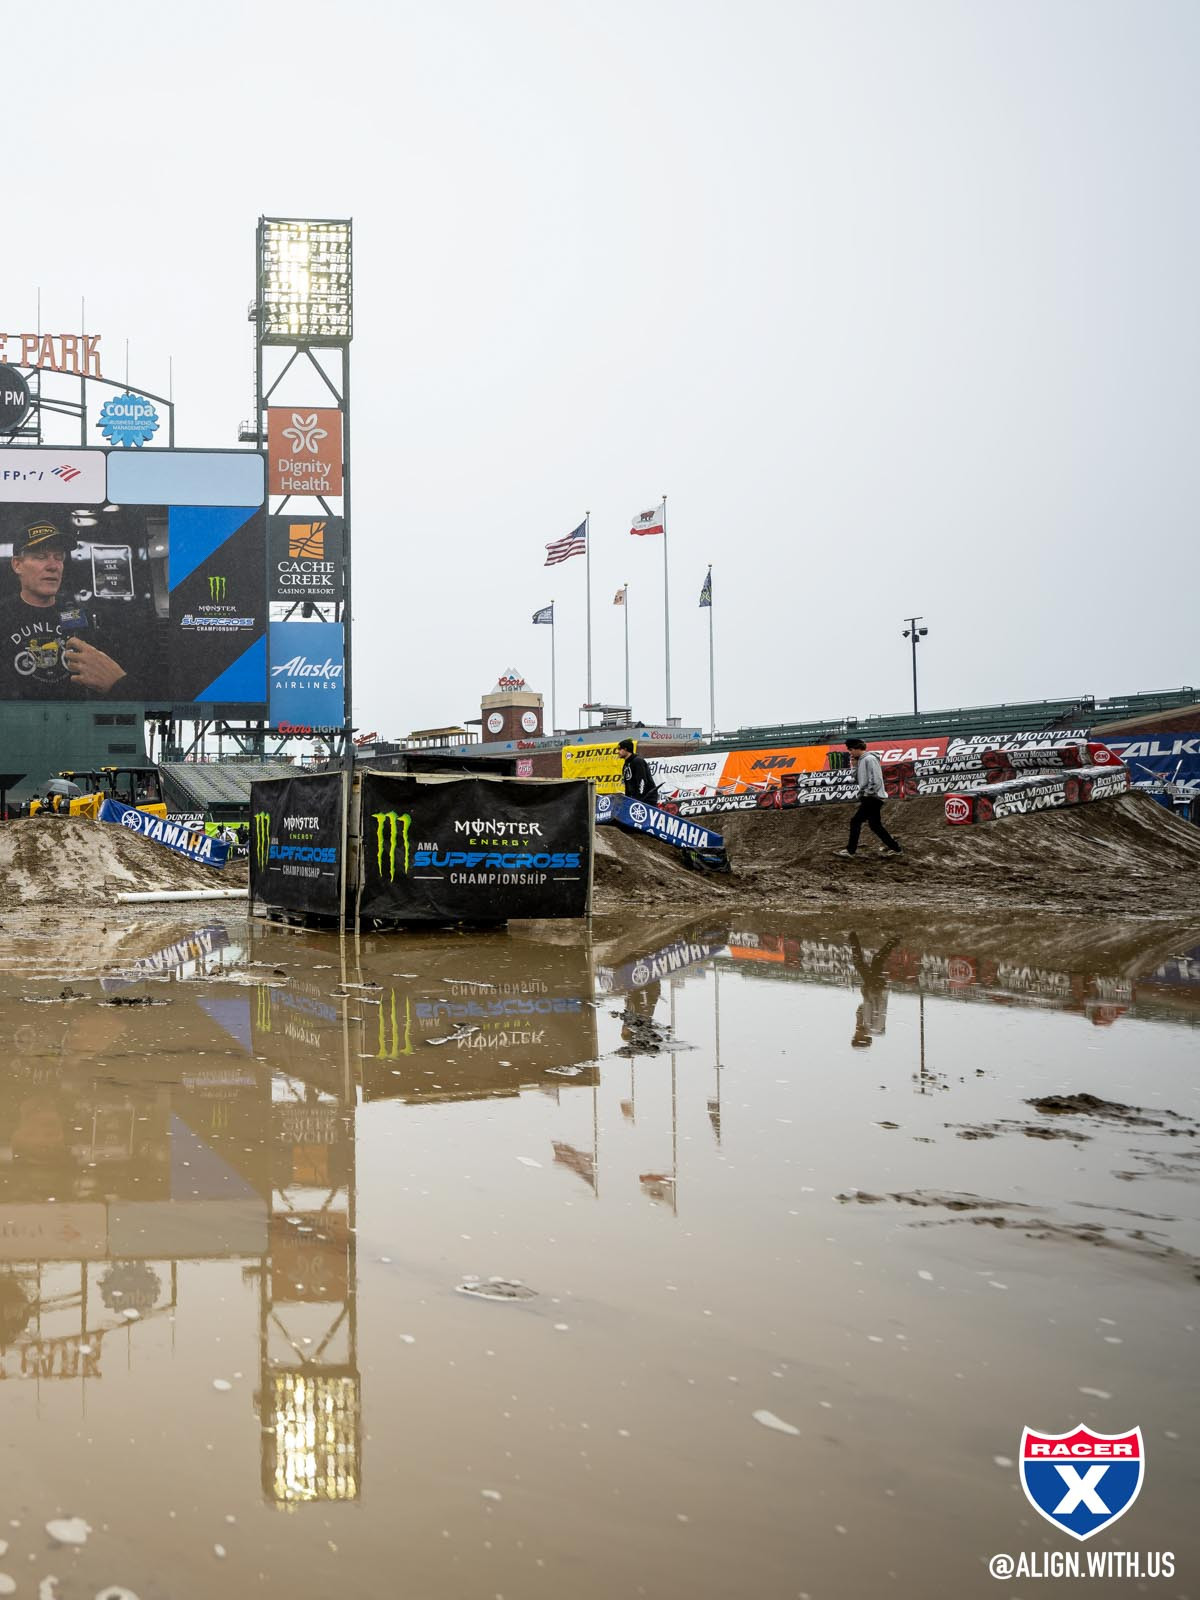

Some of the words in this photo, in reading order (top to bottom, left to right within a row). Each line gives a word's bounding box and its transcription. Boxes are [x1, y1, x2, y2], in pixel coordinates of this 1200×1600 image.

[20, 333, 103, 379] PARK
[4, 391, 25, 406] PM
[105, 404, 154, 420] coupa
[278, 459, 332, 475] Dignity
[281, 477, 330, 491] Health
[278, 561, 335, 573] CACHE
[279, 574, 333, 586] CREEK
[180, 617, 256, 626] SUPERCROSS
[10, 622, 63, 645] DUNLO
[271, 656, 343, 680] Alaska
[498, 676, 525, 687] Coors
[278, 720, 312, 733] Coors
[313, 725, 342, 733] LIGHT
[650, 731, 672, 741] Coors
[969, 734, 1013, 744] ROCKY
[1014, 730, 1088, 742] MOUNTAIN
[750, 756, 797, 770] KTM
[946, 753, 981, 763] MOUNTAIN
[658, 763, 717, 774] Husqvarna
[928, 776, 950, 784] ROCKY
[950, 772, 987, 781] MOUNTAIN
[691, 798, 716, 806] ROCKY
[716, 794, 757, 803] MOUNTAIN
[947, 803, 967, 816] RM
[166, 813, 204, 821] OUNTAIN
[284, 815, 319, 831] MONSTER
[455, 818, 543, 837] MONSTER
[648, 809, 708, 848] YAMAHA
[144, 816, 212, 858] YAMAHA
[469, 839, 530, 847] ENERGY
[417, 842, 439, 851] AMA
[270, 845, 337, 864] SUPERCROSS
[413, 852, 582, 869] SUPERCROSS
[283, 865, 320, 878] CHAMPIONSHIP
[450, 872, 548, 885] CHAMPIONSHIP
